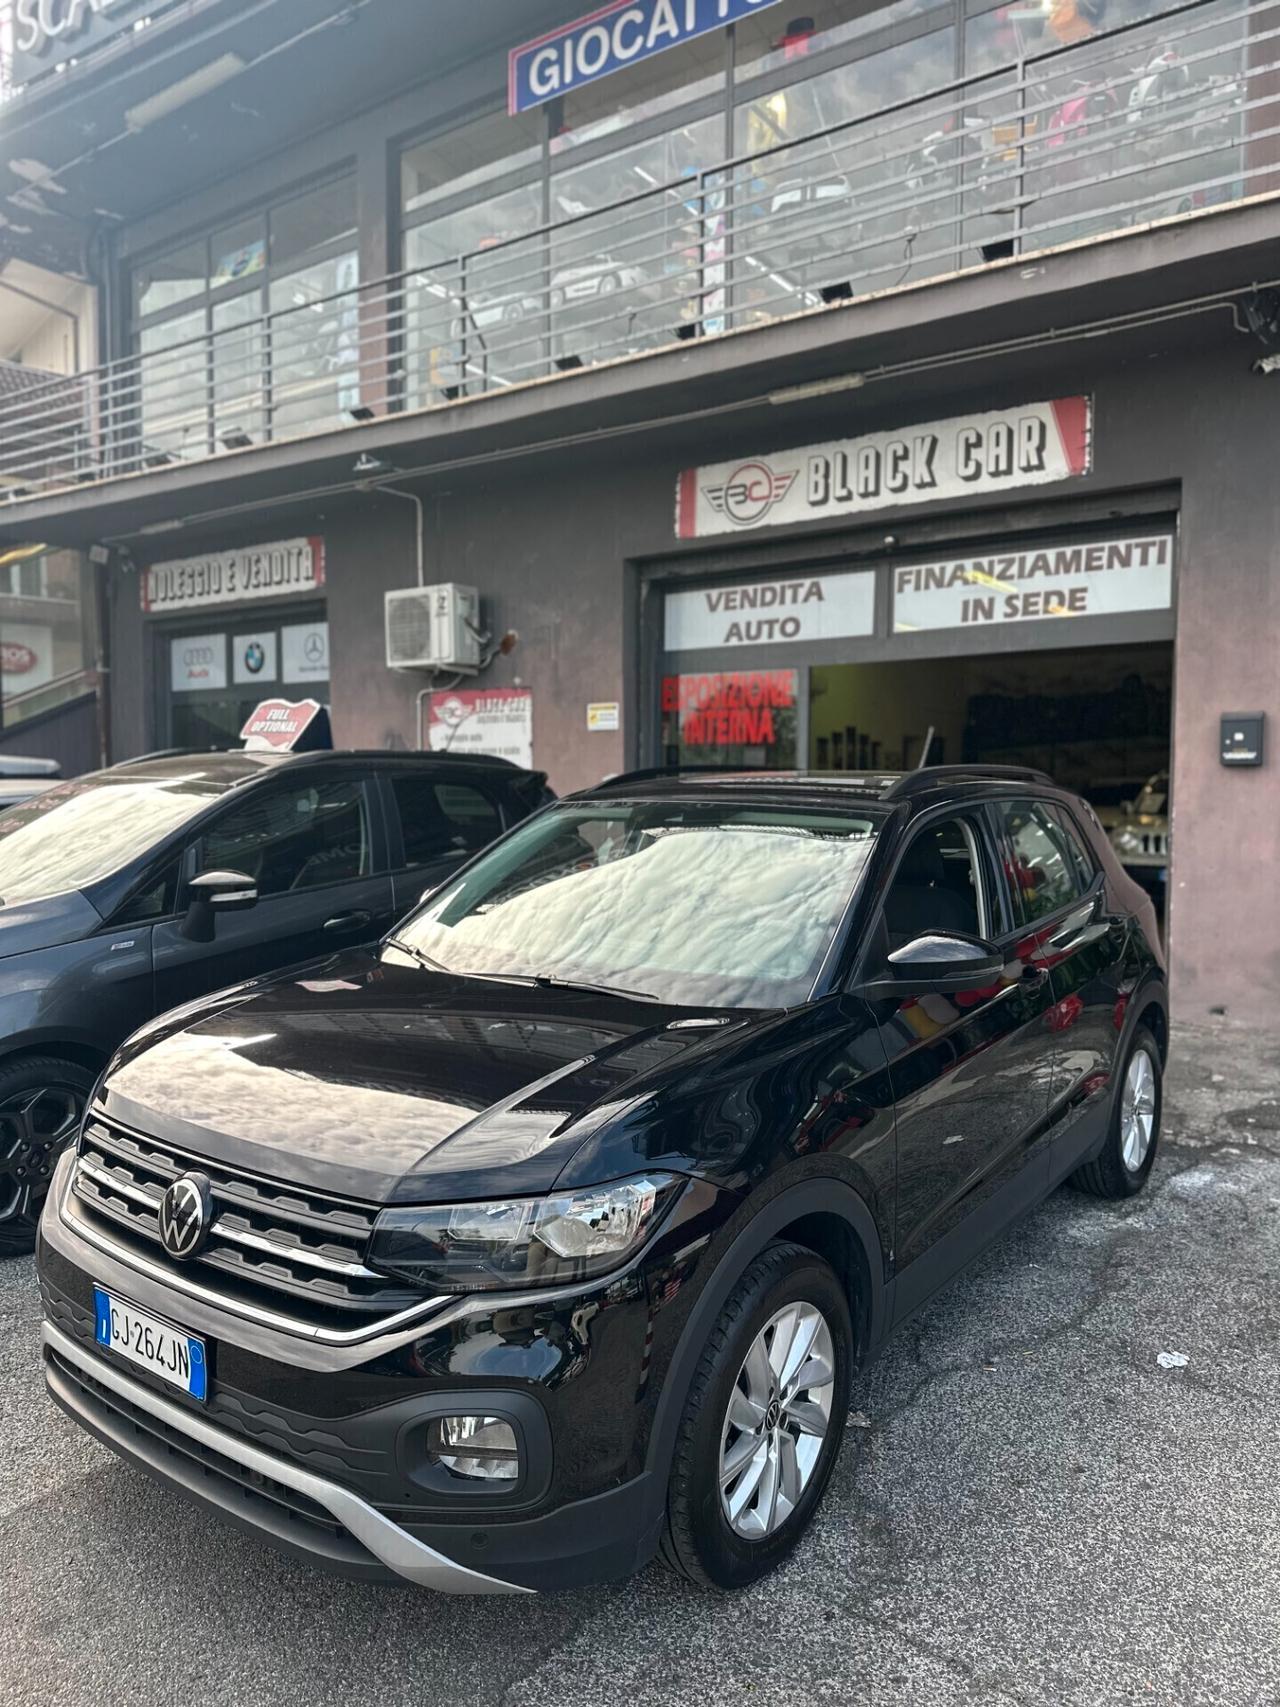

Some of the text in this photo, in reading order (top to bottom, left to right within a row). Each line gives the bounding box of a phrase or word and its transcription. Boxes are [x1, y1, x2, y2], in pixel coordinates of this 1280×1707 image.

[17, 0, 114, 52] SC
[529, 0, 761, 96] GIOCA
[808, 415, 1046, 507] BLACK CAR
[148, 545, 315, 603] NOLEGGIO E VENDITA
[897, 539, 1169, 594] FINANZIAMENTI
[705, 580, 825, 613] VENDITA
[961, 587, 1089, 623] IN SEDE
[724, 617, 802, 644] AUTO
[661, 670, 796, 713] ESPOSIZIONE
[250, 720, 299, 733] OPTIONAL
[266, 708, 290, 720] FULL
[683, 707, 777, 745] INTERNA
